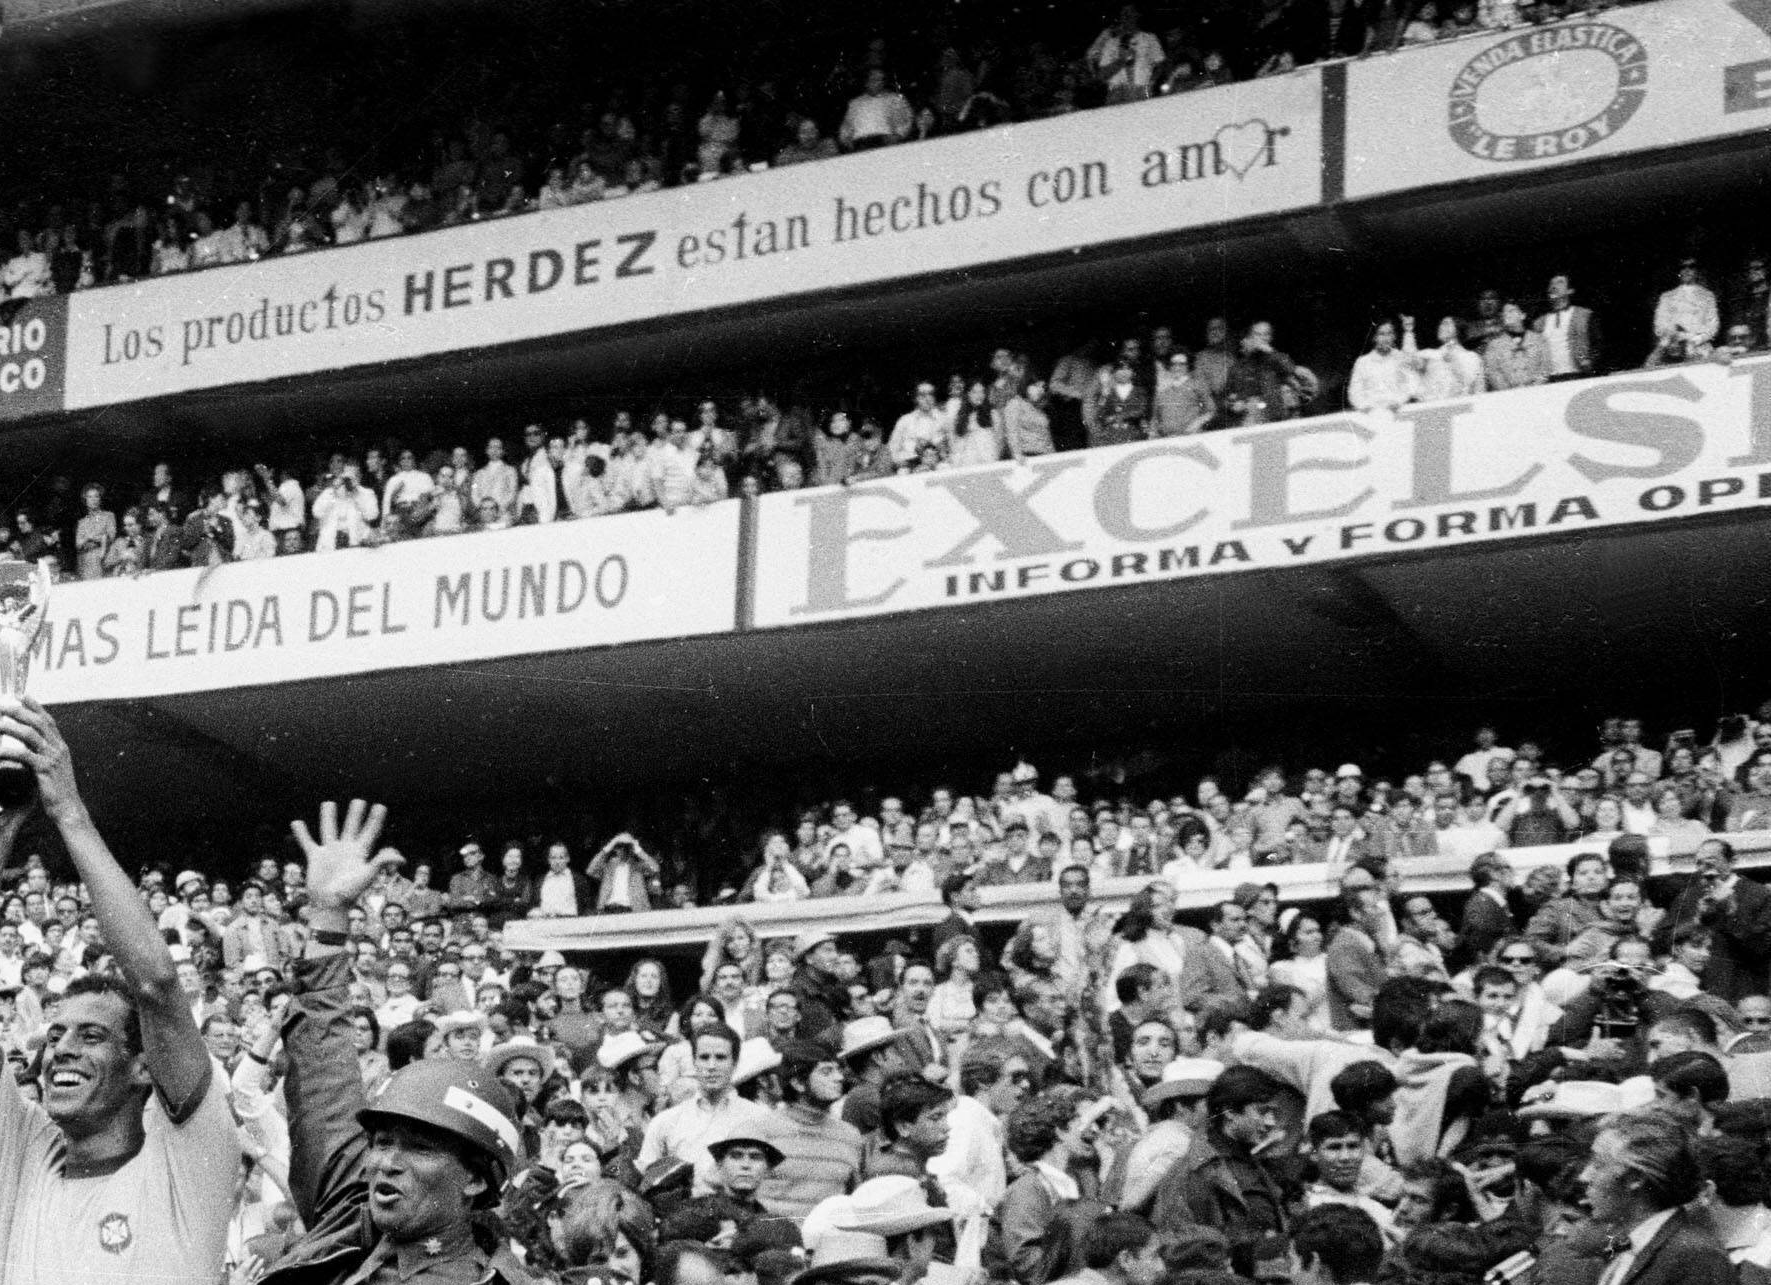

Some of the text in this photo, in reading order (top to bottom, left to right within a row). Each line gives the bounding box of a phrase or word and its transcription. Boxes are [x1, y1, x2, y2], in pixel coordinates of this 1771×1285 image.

[1450, 25, 1639, 97] VENDA ELASTICA
[102, 319, 163, 366] Los
[181, 283, 387, 367] productos
[402, 229, 659, 317] HERDEZ
[676, 209, 810, 269] estan
[834, 180, 1003, 246] hechos
[1027, 158, 1112, 209] con
[945, 537, 1253, 597] INFORMA
[1340, 495, 1601, 551] FORMA
[147, 594, 284, 661] LEIDA
[307, 580, 407, 645] DEL
[433, 553, 630, 629] MUNDO
